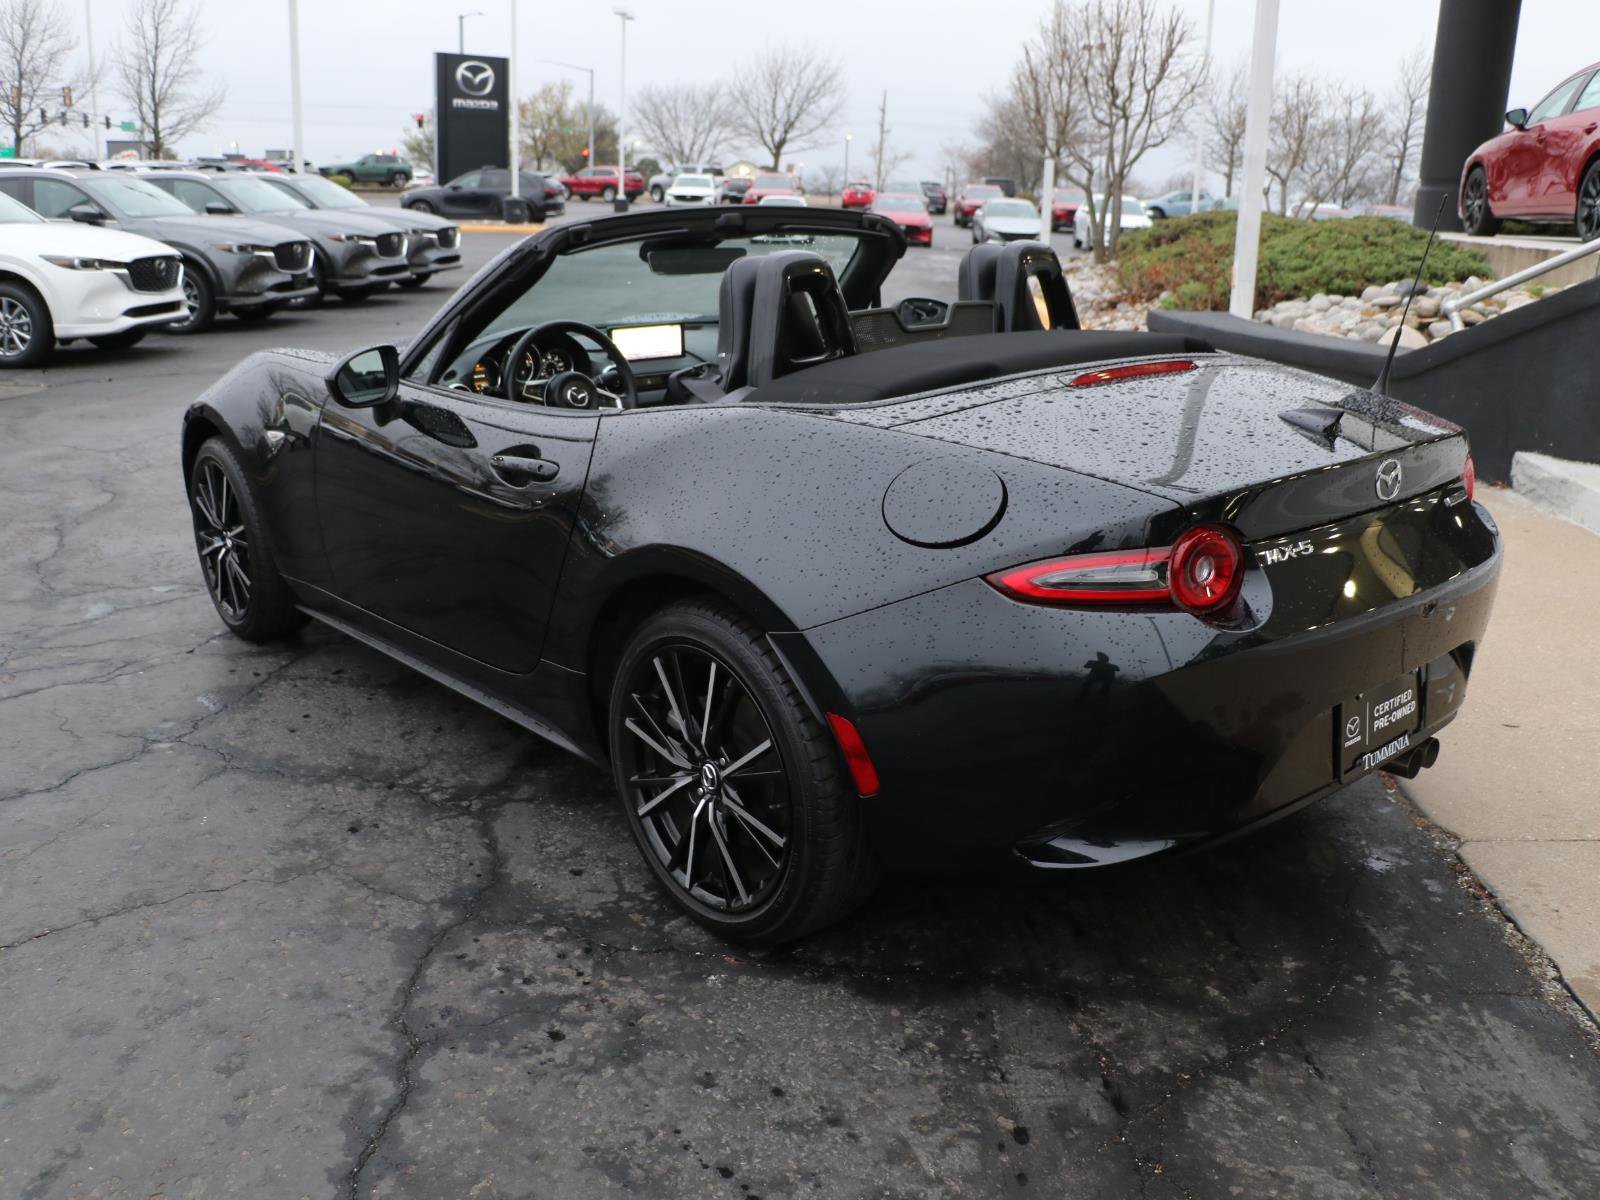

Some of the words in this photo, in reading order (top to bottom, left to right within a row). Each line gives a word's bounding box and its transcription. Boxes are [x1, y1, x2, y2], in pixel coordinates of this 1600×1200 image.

[1265, 540, 1314, 565] MX-5
[1373, 689, 1412, 717] CERTIFIED
[1373, 700, 1416, 732] PRE-OWNED
[1362, 733, 1410, 771] TUMMINIA
